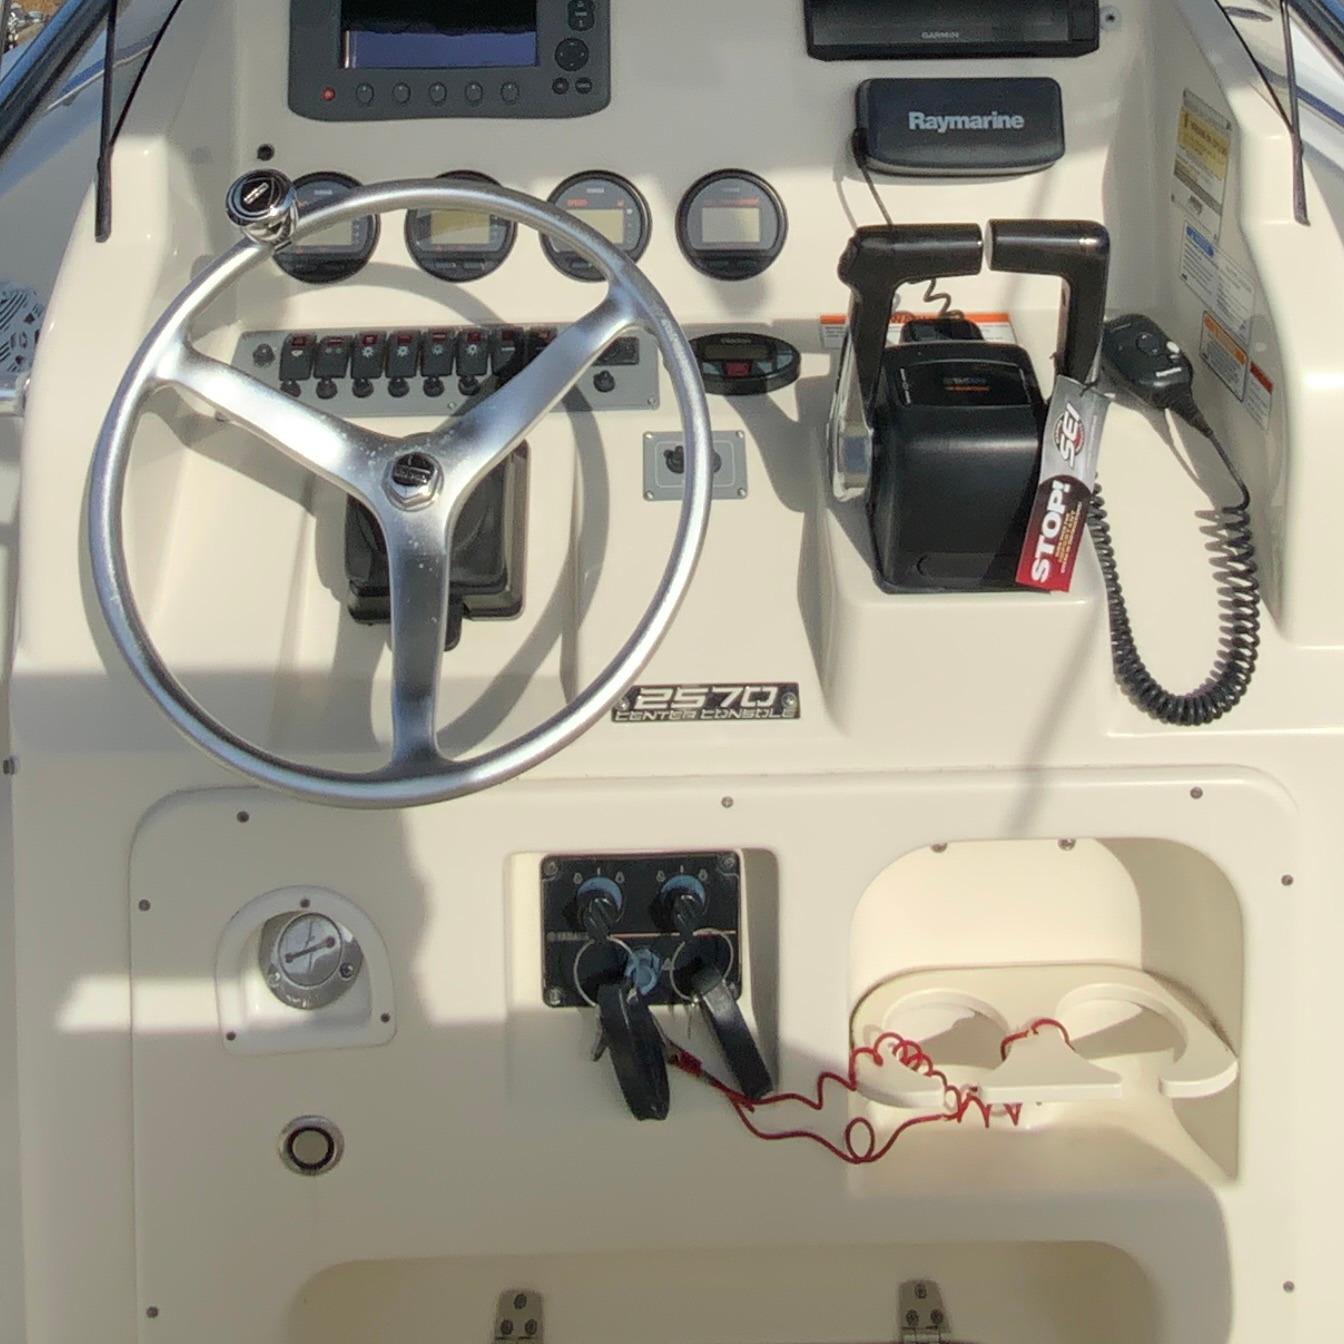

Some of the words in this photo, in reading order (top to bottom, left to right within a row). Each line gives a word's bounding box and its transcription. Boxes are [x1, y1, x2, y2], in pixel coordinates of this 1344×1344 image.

[921, 31, 960, 40] GARMIN
[908, 110, 1025, 133] Raymarine
[1059, 402, 1081, 469] SEI
[1031, 479, 1071, 584] STOP!
[634, 685, 779, 710] 2570
[615, 708, 696, 722] CENTER
[699, 706, 796, 721] CONSOLE
